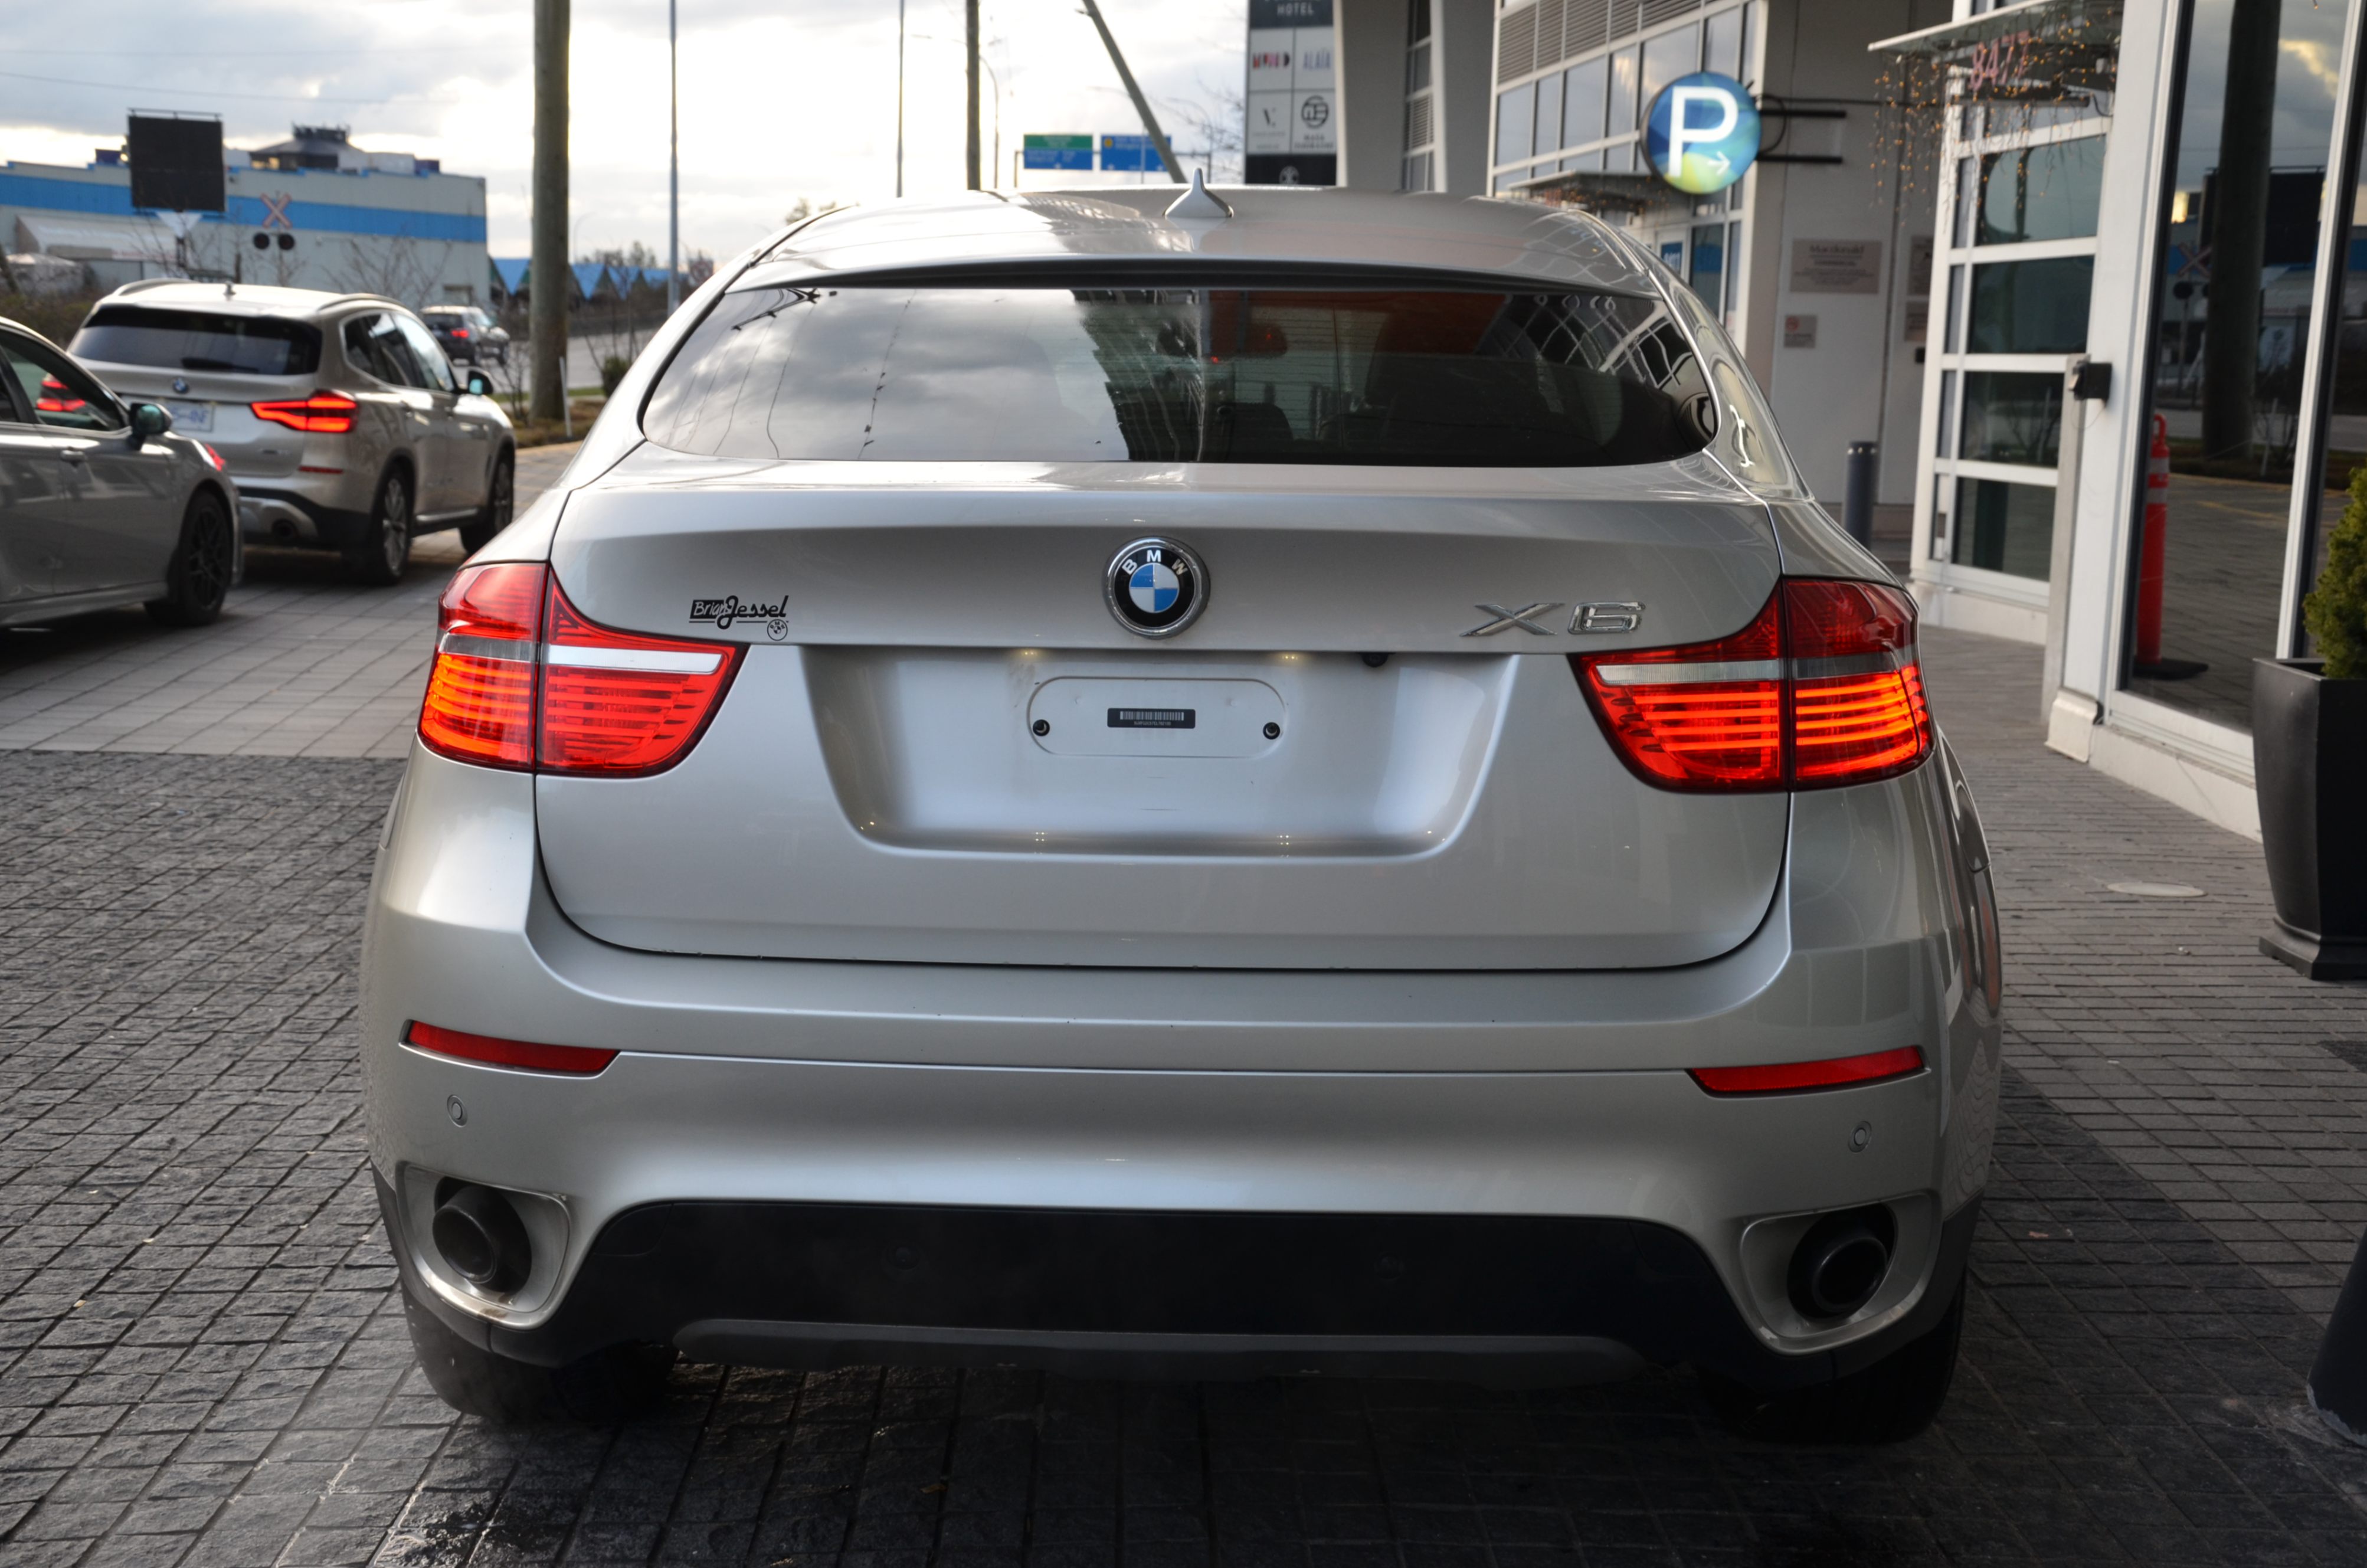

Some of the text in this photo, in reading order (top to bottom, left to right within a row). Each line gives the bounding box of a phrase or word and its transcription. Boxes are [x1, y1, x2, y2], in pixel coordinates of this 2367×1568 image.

[1277, 2, 1314, 16] HOTEL
[1668, 86, 1739, 178] P
[1122, 549, 1188, 575] BMW
[716, 595, 789, 630] Jessel
[770, 621, 785, 630] BMW
[1459, 601, 1646, 637] X6
